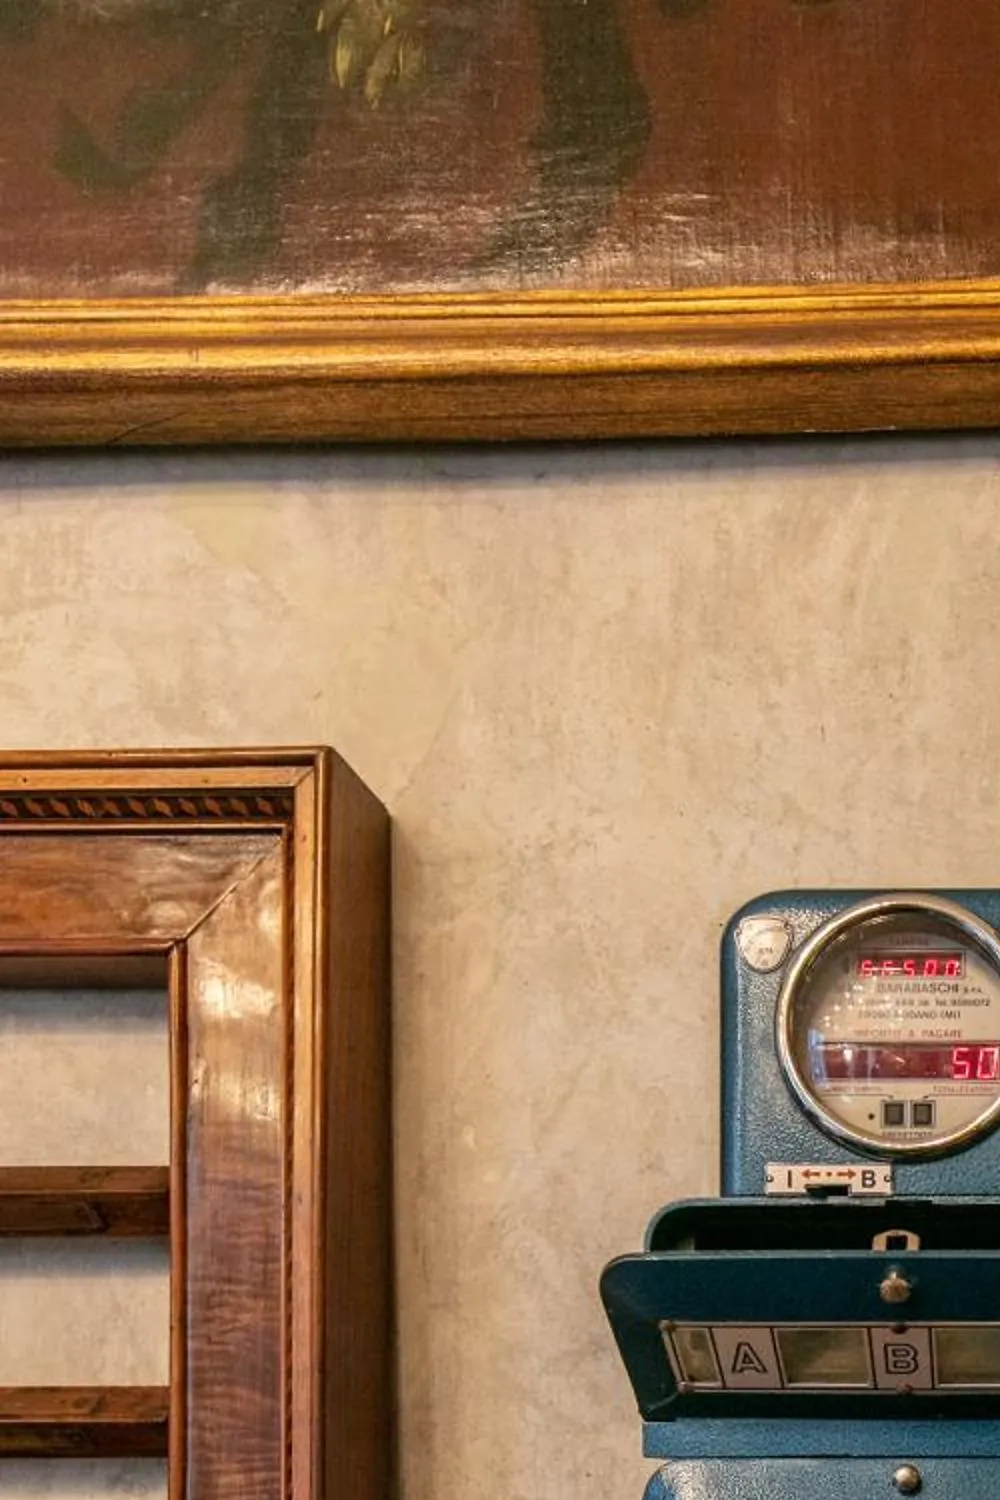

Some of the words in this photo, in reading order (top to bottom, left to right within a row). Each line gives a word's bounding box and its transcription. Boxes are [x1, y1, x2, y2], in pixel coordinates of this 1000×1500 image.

[952, 1047, 999, 1079] 50
[860, 1170, 877, 1188] B
[731, 1342, 767, 1375] A
[884, 1343, 919, 1375] B
